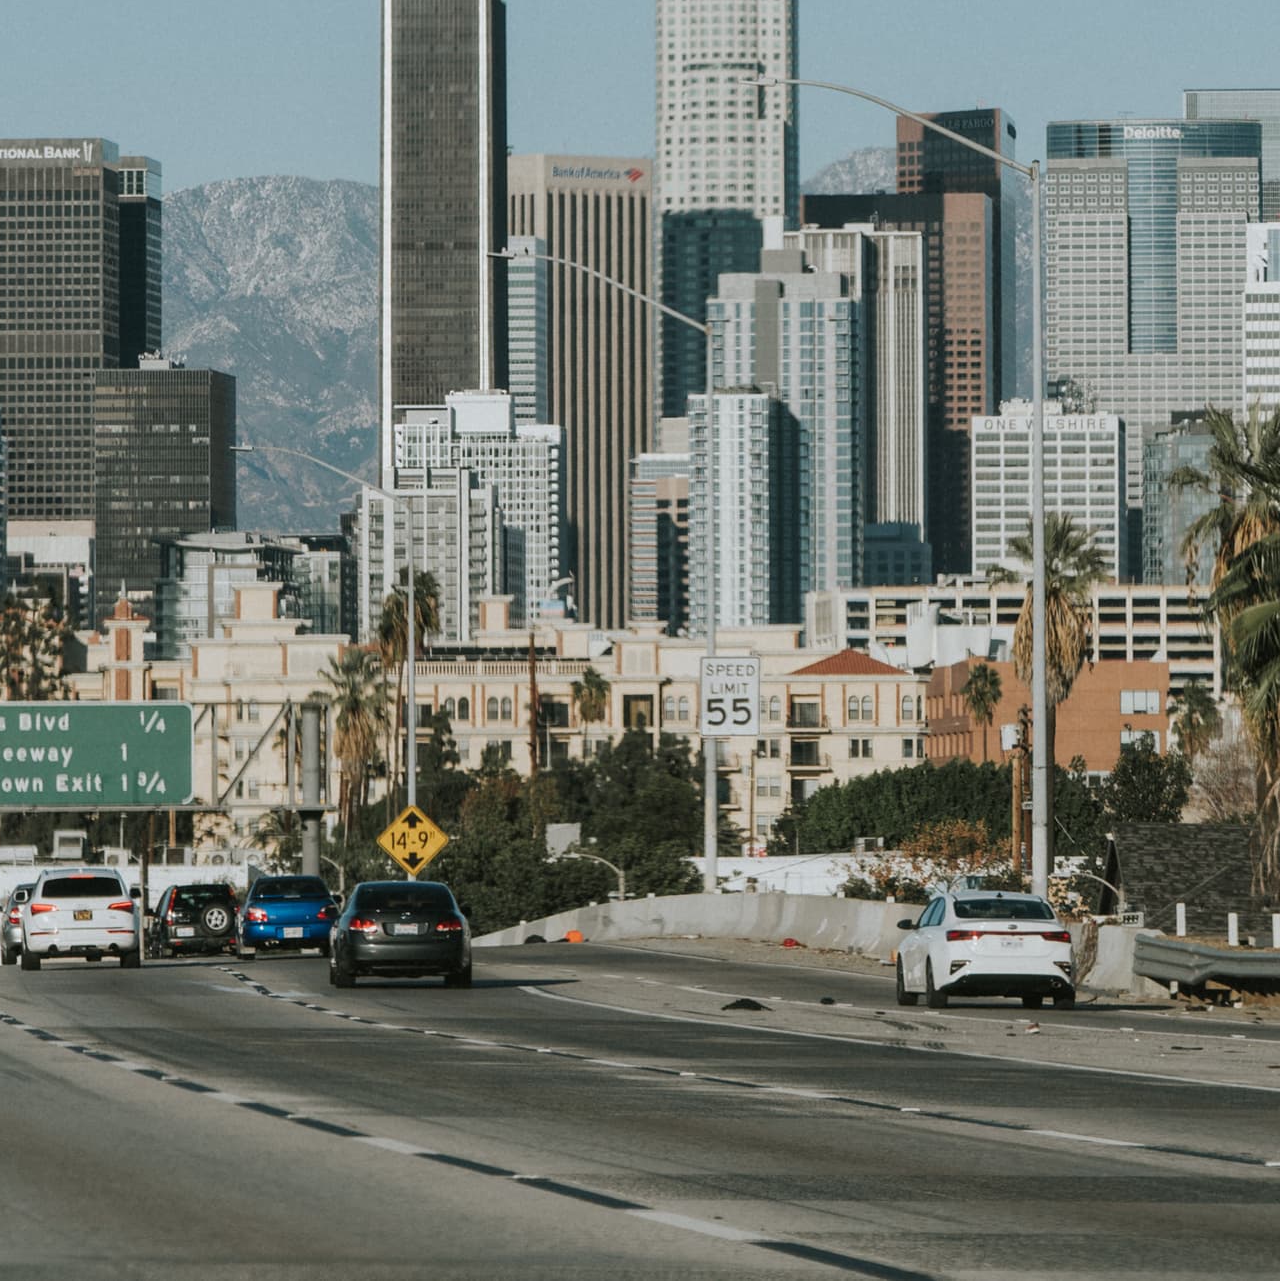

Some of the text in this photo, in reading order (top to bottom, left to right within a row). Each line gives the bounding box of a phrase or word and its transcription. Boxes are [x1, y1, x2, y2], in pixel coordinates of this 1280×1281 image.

[984, 419, 1107, 430] ONE WLSHIRE
[705, 663, 756, 677] SPEED
[710, 682, 750, 695] LIMIT
[706, 698, 752, 726] 55
[19, 713, 70, 732] Blvd
[121, 743, 128, 762] 1
[56, 773, 103, 793] Exit
[121, 773, 128, 792] 1
